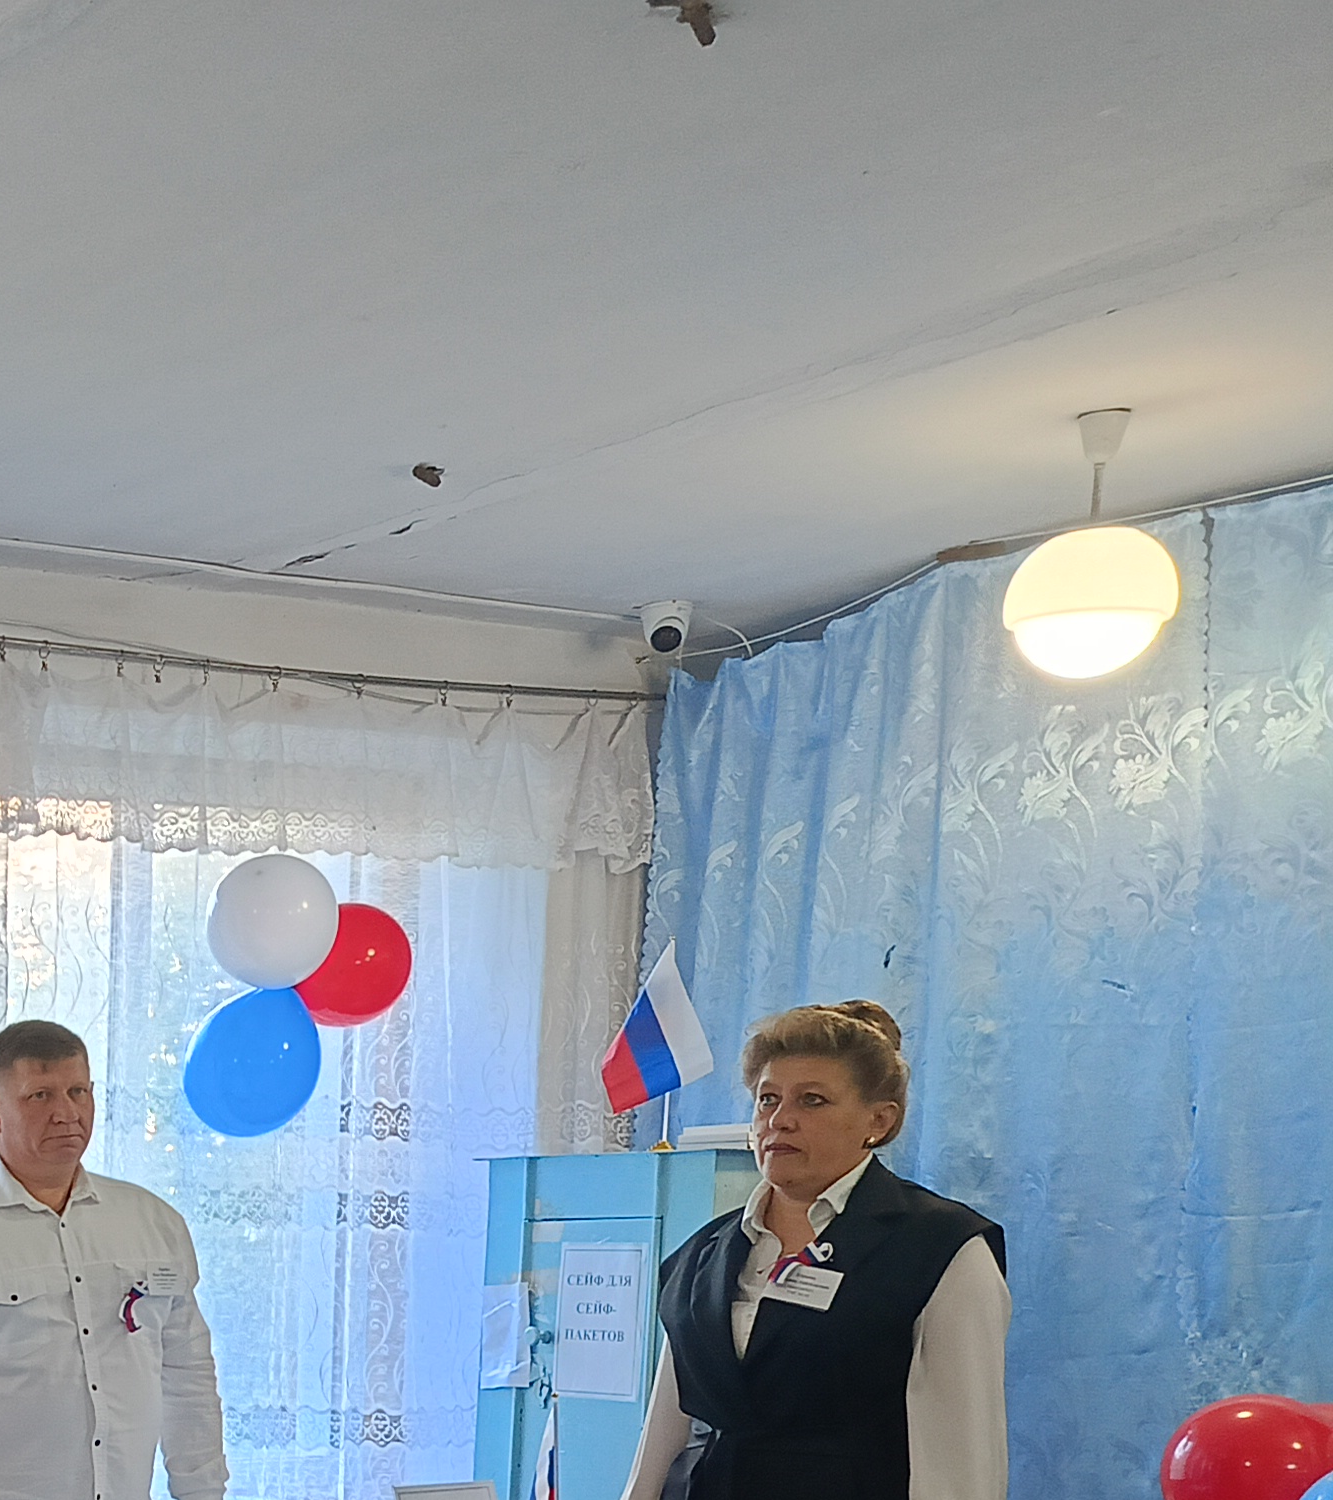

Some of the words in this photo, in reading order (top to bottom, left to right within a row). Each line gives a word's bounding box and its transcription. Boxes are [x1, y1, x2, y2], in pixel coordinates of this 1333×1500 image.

[567, 1272, 604, 1287] СЕЙФ
[606, 1275, 632, 1287] ДЛЯ
[576, 1300, 617, 1315] СЕЙФ-
[565, 1329, 625, 1342] ПАКЕТОВ
